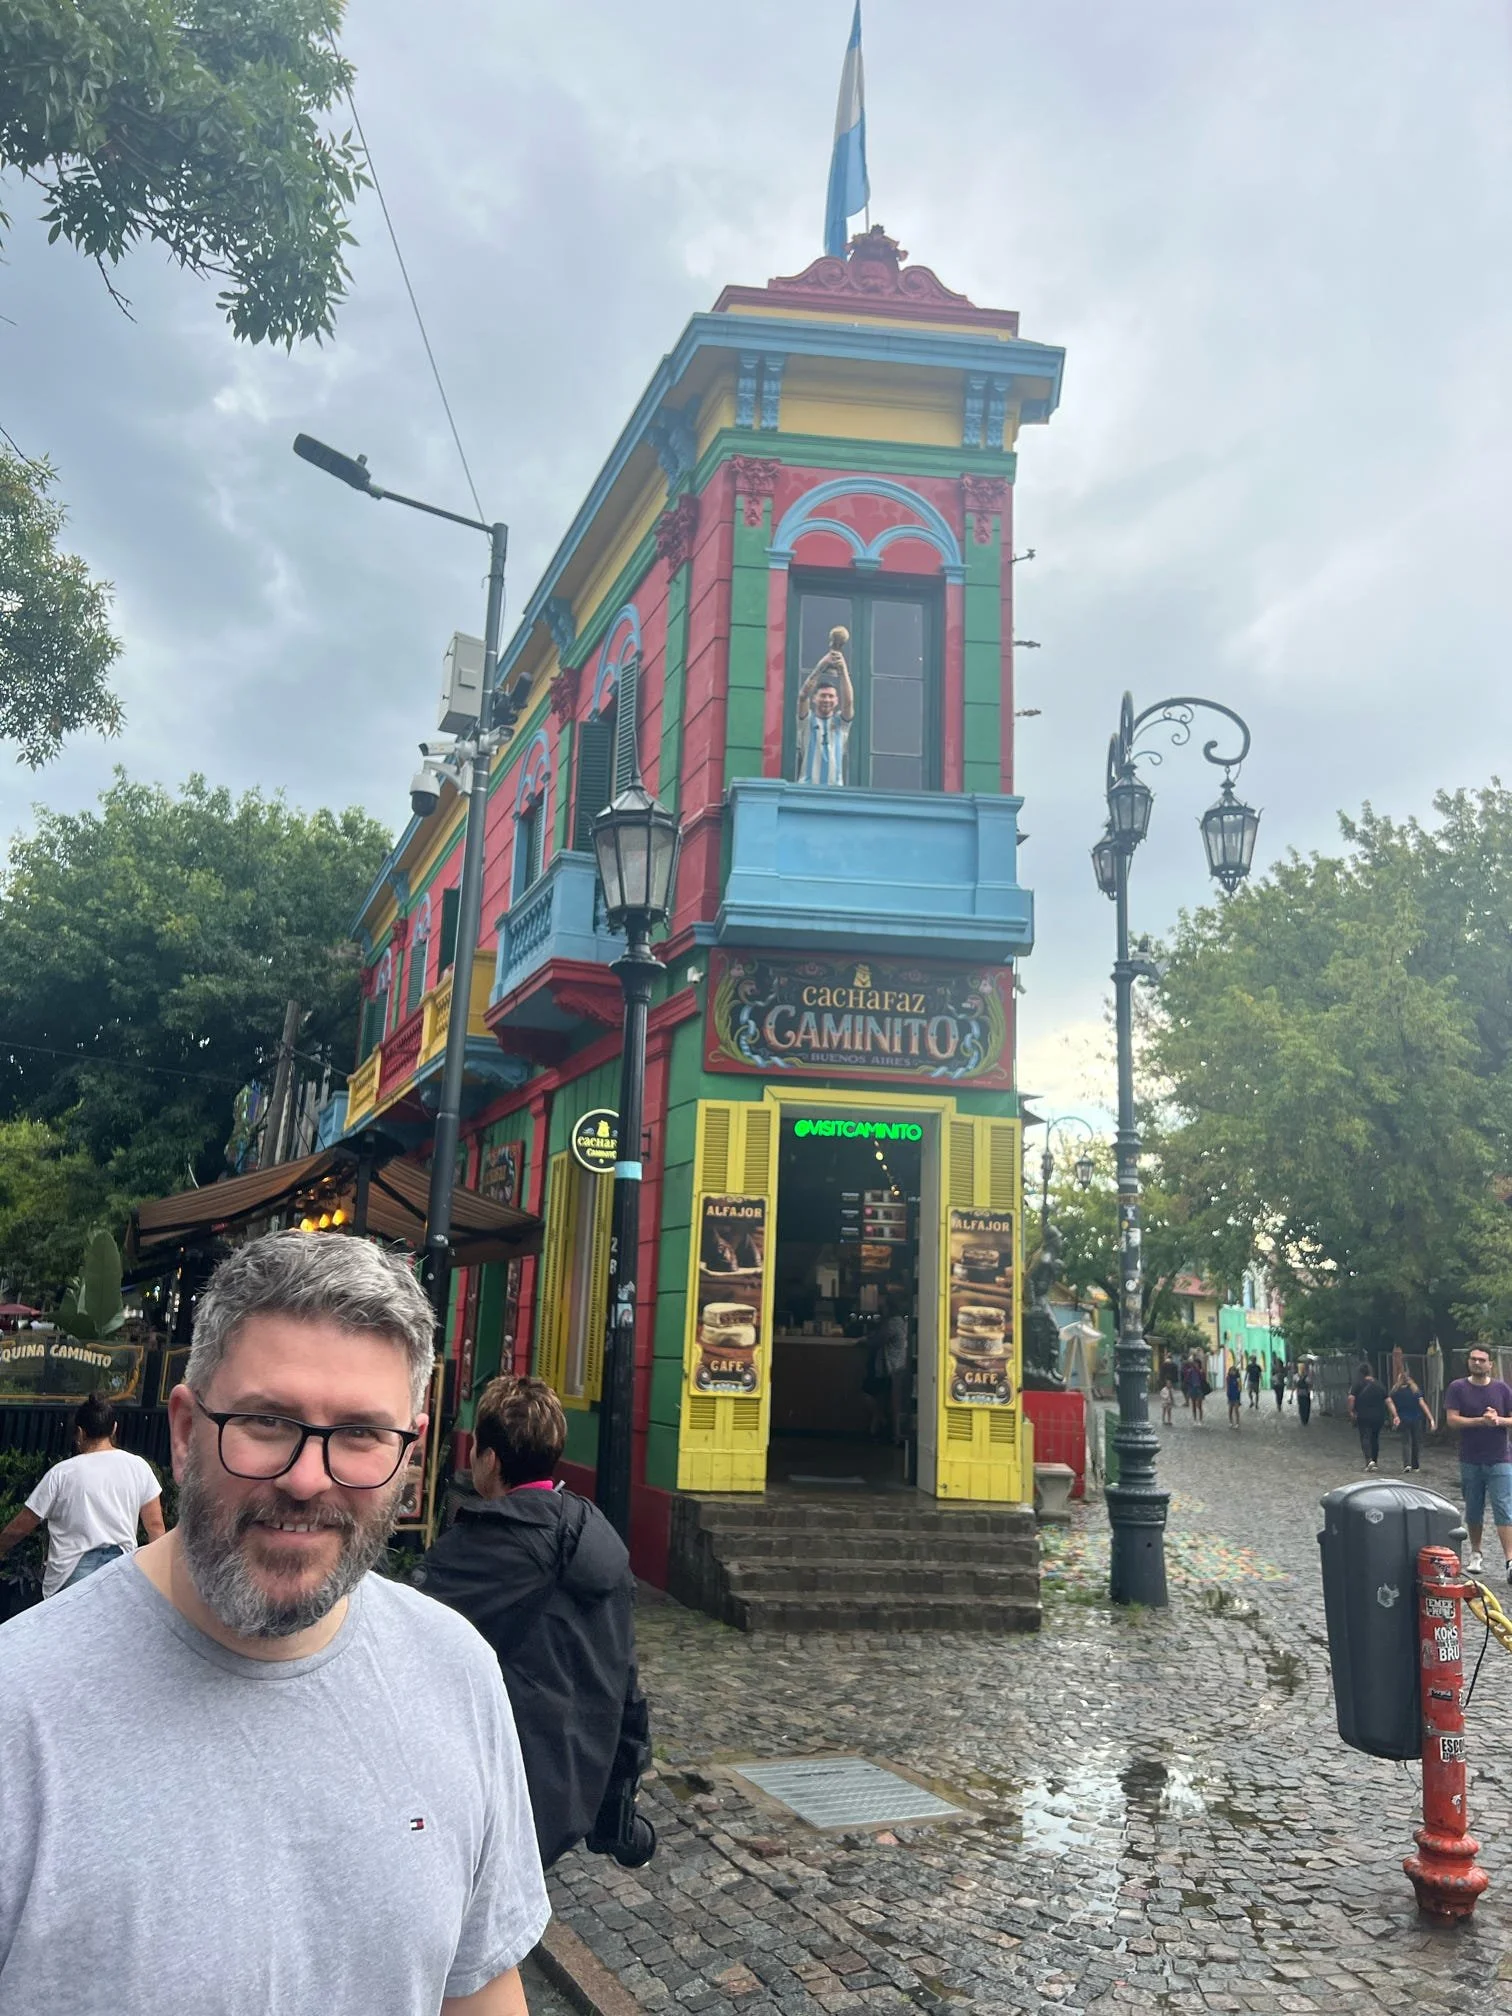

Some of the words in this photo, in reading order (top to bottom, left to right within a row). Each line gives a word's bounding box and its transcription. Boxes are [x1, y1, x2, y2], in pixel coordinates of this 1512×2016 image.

[764, 1004, 961, 1059] CAMINITO
[810, 1052, 866, 1065] BUENOS
[870, 1056, 912, 1067] AIRES
[706, 1205, 763, 1218] ALFAJOR
[952, 1218, 1010, 1232] ALFAJOR
[0, 1343, 46, 1363] QUINA
[50, 1343, 113, 1368] CAMINITO
[709, 1360, 745, 1372] CAFE
[964, 1371, 999, 1385] CAFE
[1439, 1646, 1461, 1662] BRU
